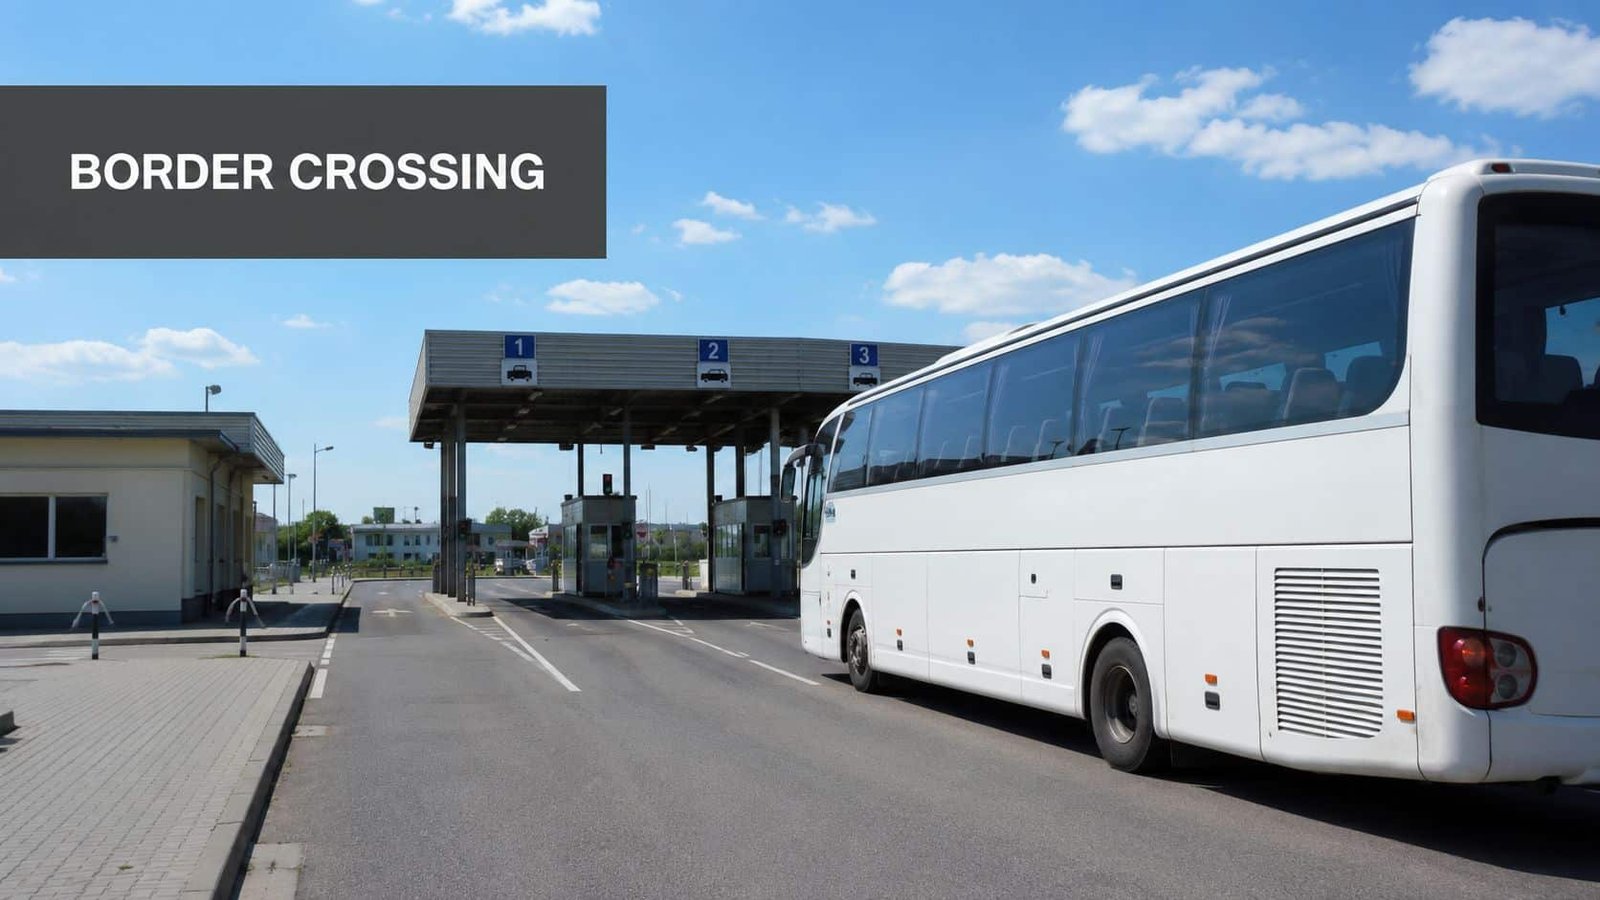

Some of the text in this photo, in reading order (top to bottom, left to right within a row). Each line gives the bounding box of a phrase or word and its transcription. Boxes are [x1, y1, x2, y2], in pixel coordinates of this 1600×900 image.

[515, 337, 523, 356] 1
[708, 342, 719, 359] 2
[859, 346, 870, 364] 3
